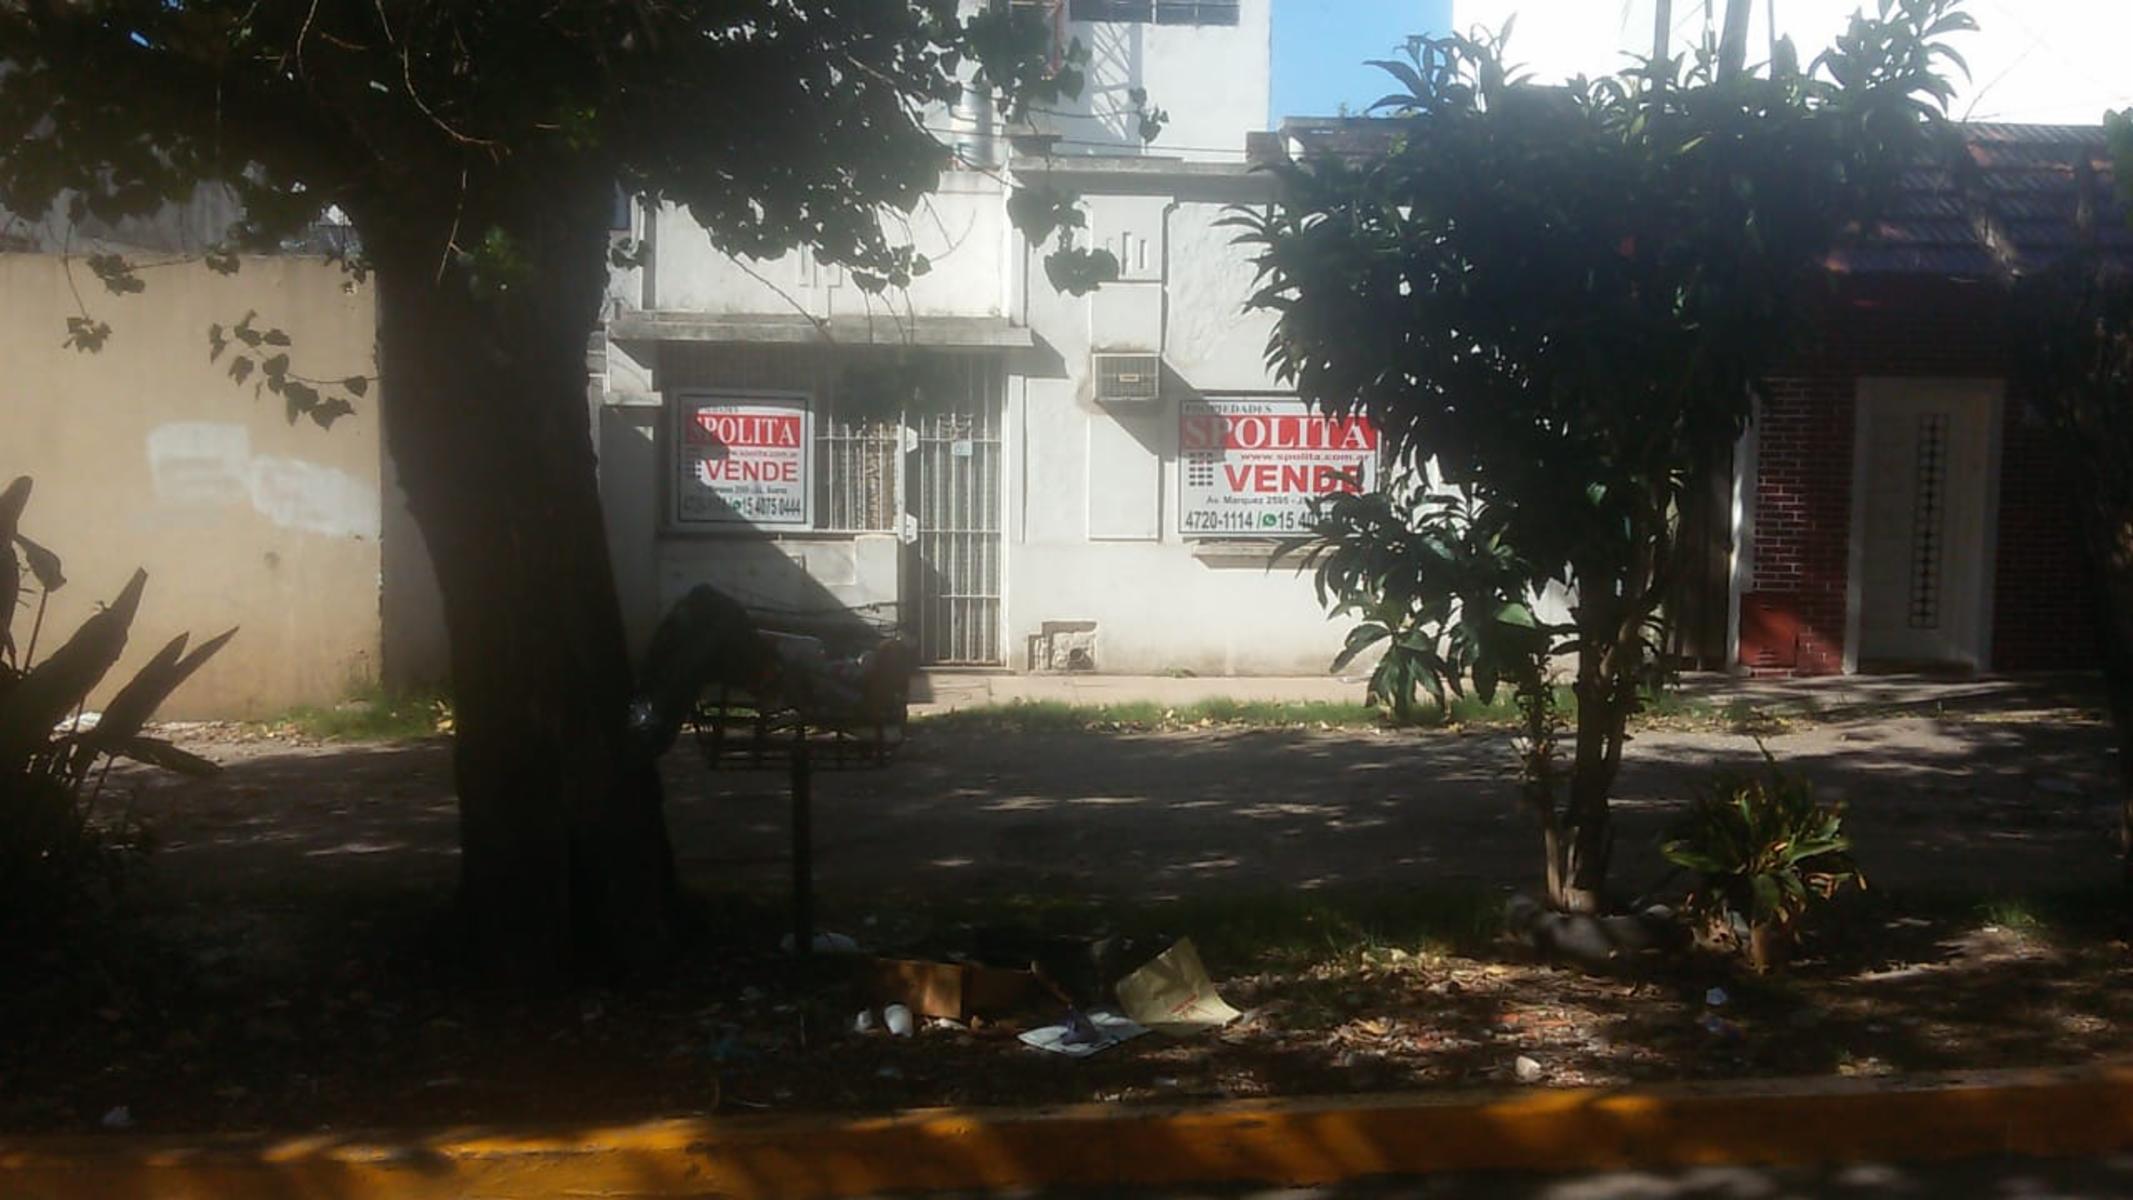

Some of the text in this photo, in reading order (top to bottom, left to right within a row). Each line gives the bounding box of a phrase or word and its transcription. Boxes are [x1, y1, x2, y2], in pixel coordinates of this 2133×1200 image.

[696, 416, 797, 446] POLITA
[1185, 417, 1370, 449] SPOLITA
[704, 458, 798, 482] VENDE
[1240, 453, 1371, 463] www.spolita.com.ar
[1223, 464, 1365, 493] VENDE
[1185, 510, 1253, 530] 4720-1114
[1278, 511, 1294, 530] 15
